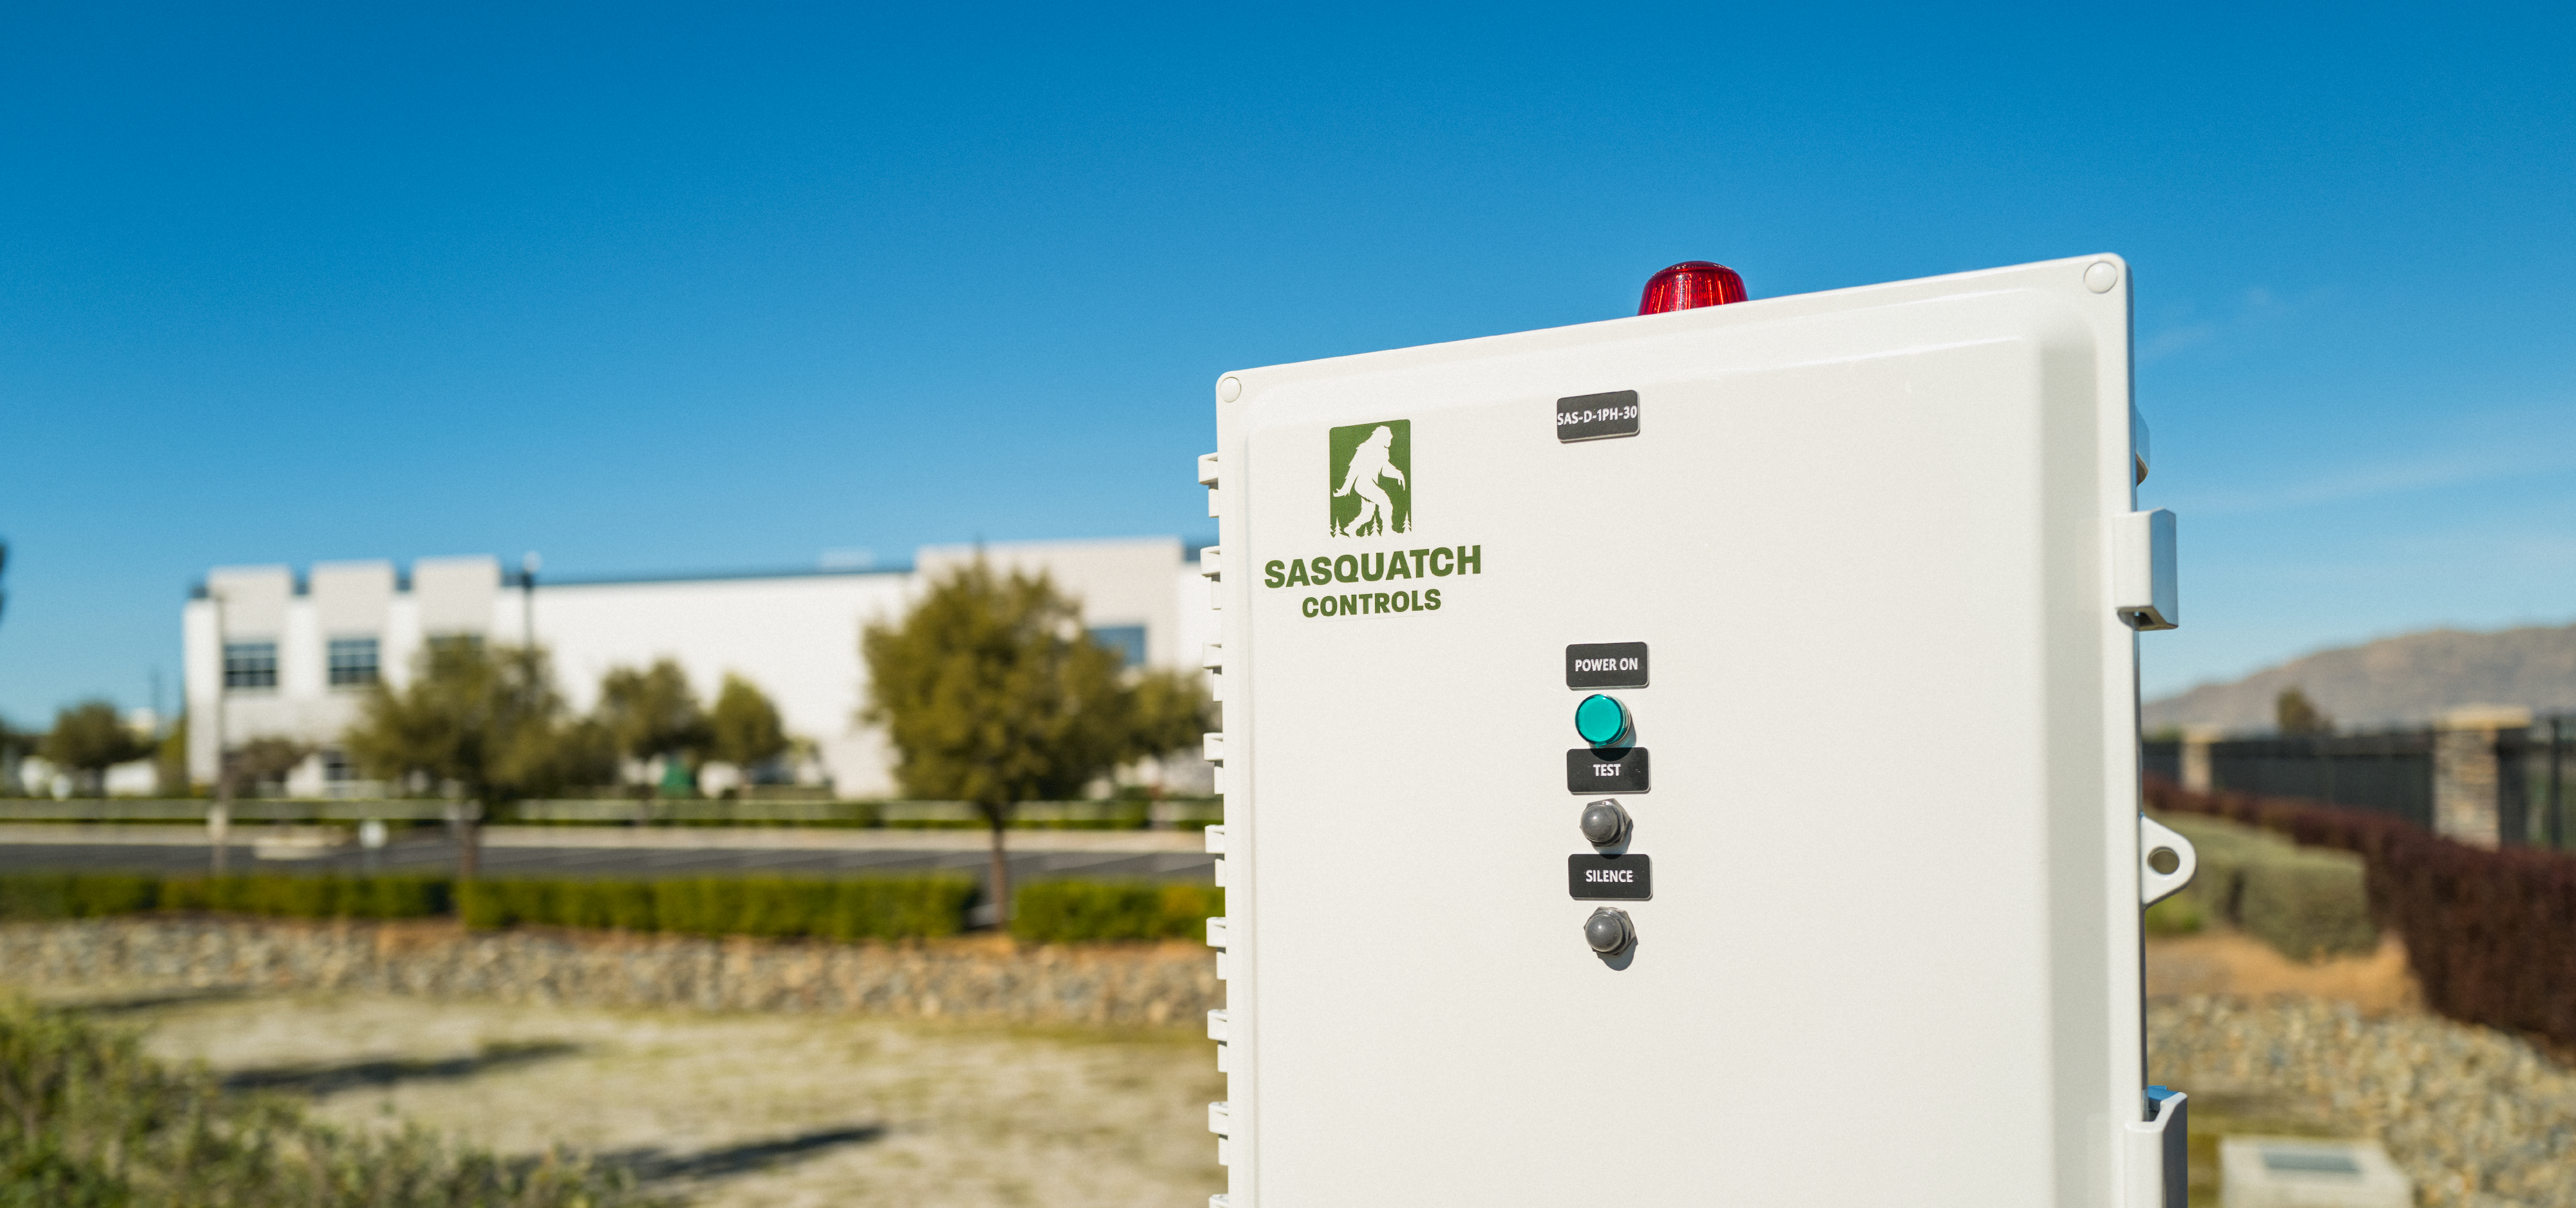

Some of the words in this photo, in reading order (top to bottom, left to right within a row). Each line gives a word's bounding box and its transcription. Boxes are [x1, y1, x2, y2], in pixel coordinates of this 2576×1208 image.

[1557, 405, 1637, 426] SAS-D-1PH-30
[1264, 545, 1481, 588] SASQUATCH
[1302, 589, 1441, 618] CONTROLS
[1575, 658, 1616, 672] POWER
[1619, 657, 1638, 671] ON
[1593, 763, 1621, 777] TEST
[1586, 870, 1633, 883] SILENCE
